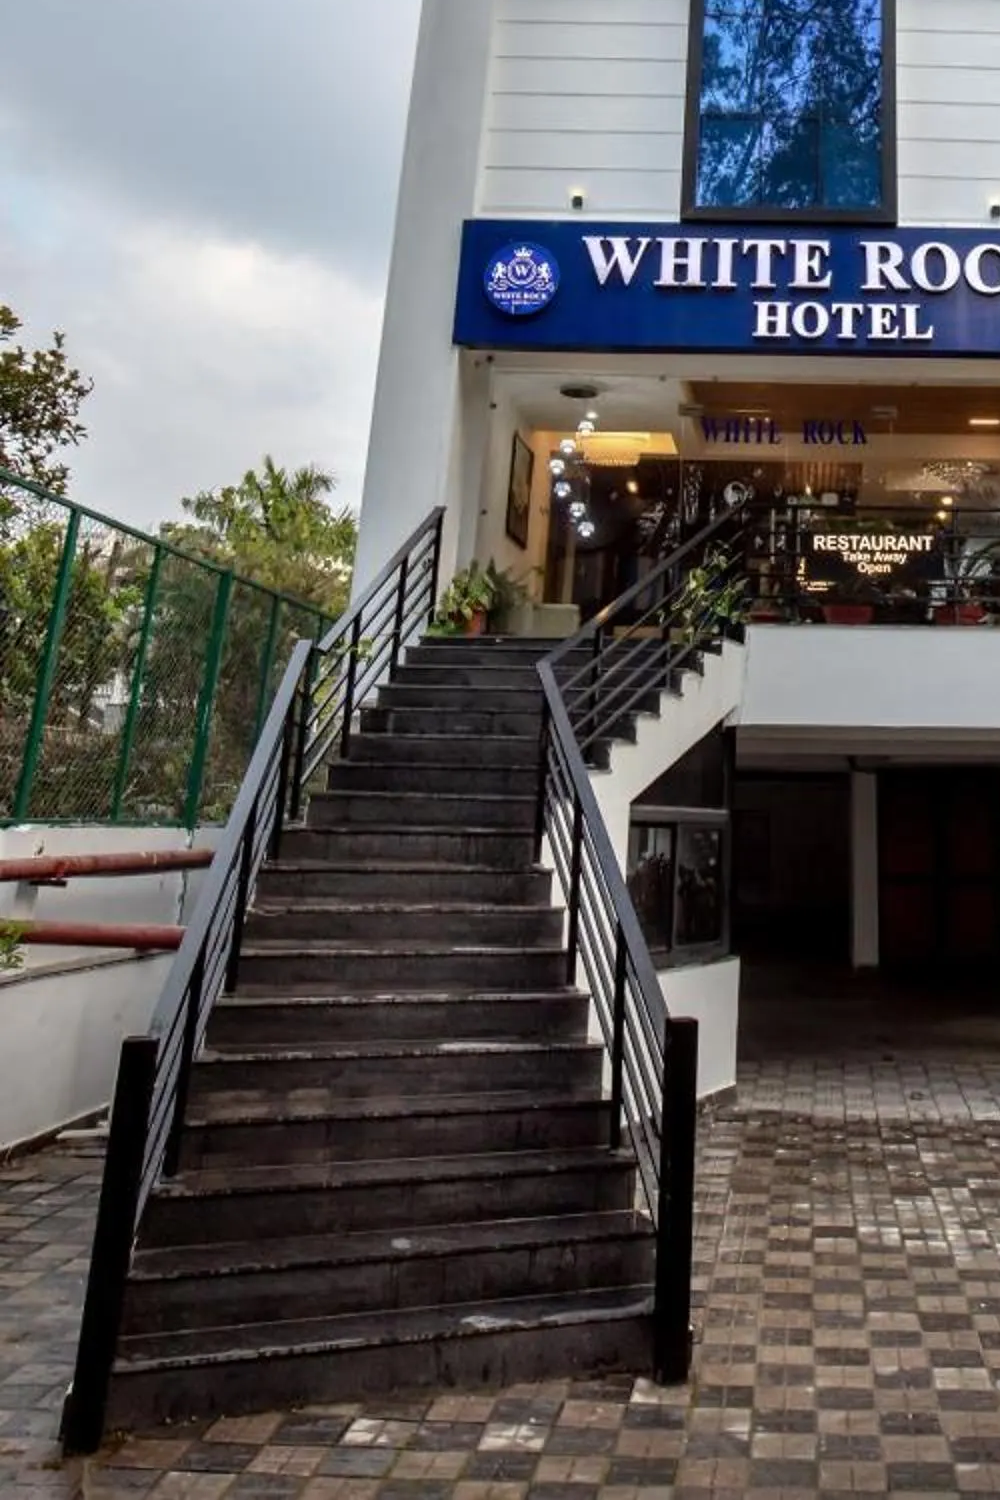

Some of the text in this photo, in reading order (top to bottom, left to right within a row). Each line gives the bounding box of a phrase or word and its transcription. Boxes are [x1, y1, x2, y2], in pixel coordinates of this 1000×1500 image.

[582, 235, 832, 288] WHITE
[752, 300, 934, 340] HOTEL
[803, 419, 867, 445] ROCK
[813, 534, 934, 551] RESTAURANT
[841, 551, 907, 565] Take Away
[856, 561, 892, 575] Open
